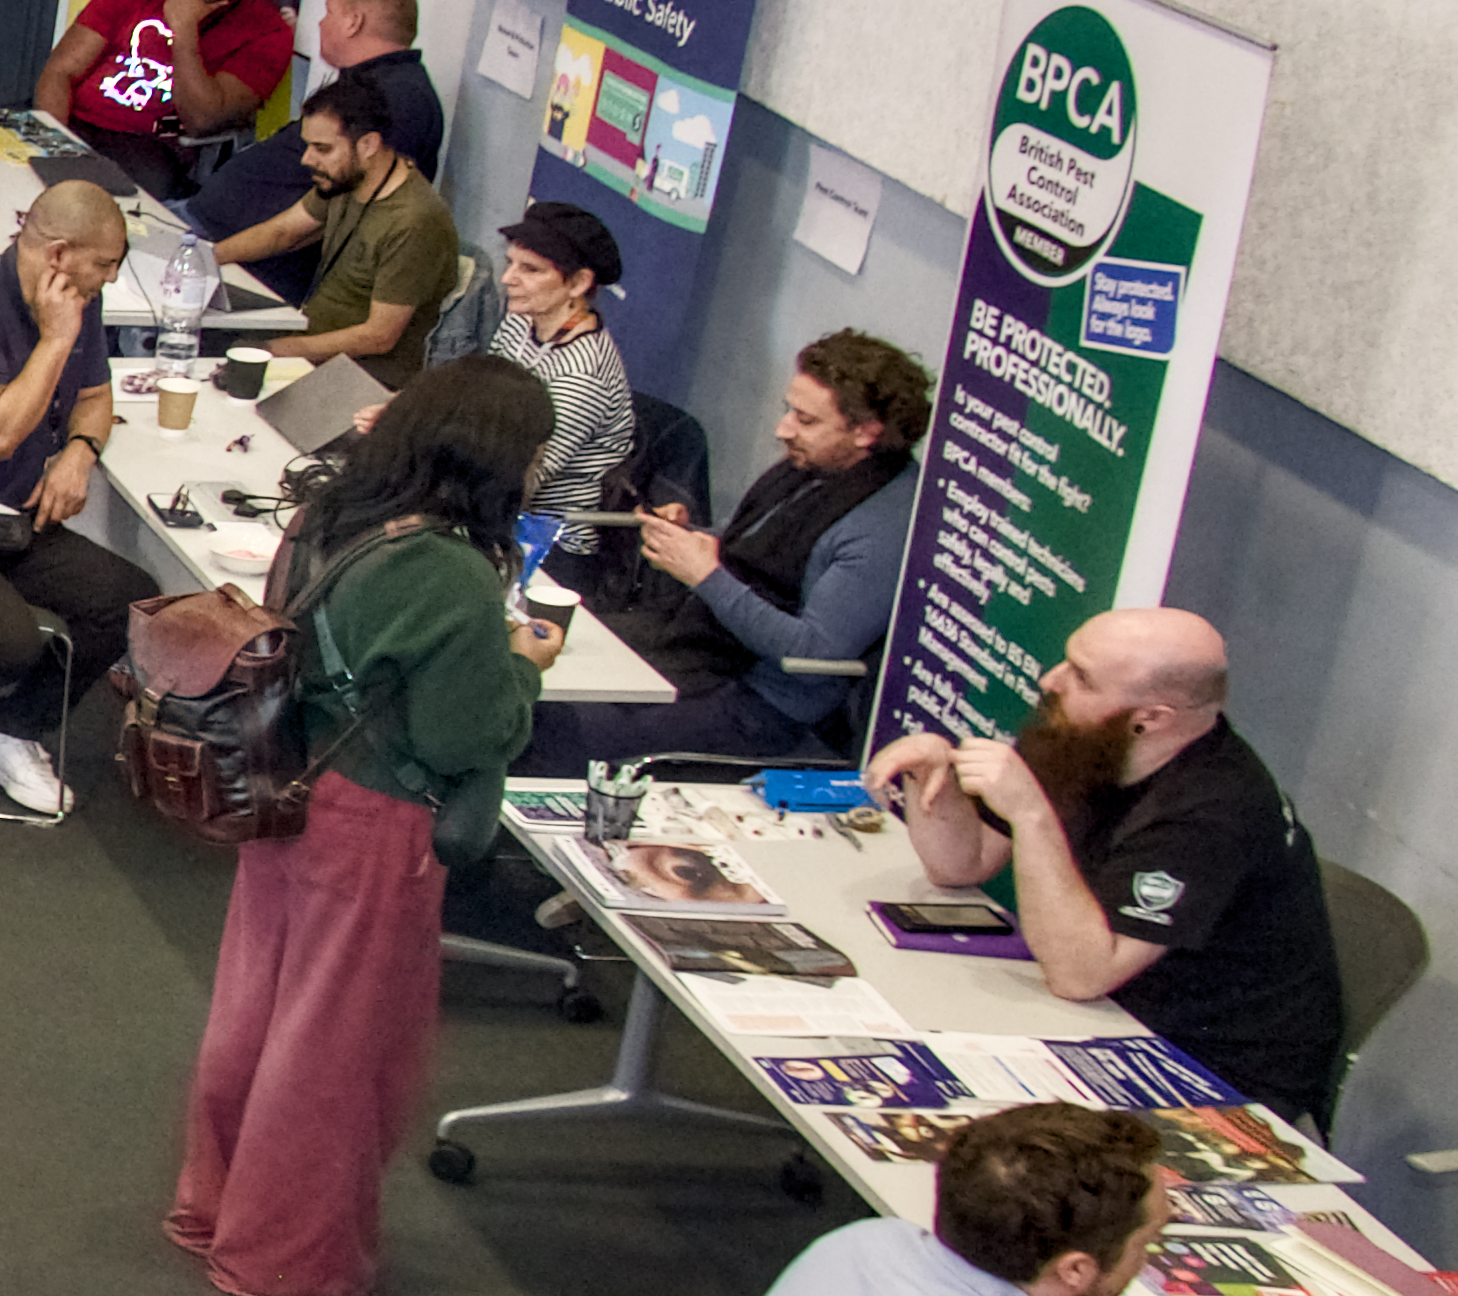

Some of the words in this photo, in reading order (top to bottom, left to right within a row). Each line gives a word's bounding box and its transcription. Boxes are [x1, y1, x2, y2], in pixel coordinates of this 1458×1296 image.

[1015, 42, 1123, 145] BPCA
[1019, 134, 1063, 172] British
[1066, 159, 1096, 189] Pest
[1027, 166, 1079, 206] Control
[1007, 184, 1085, 238] Association
[970, 298, 1001, 338] BE
[999, 314, 1112, 408] PROTECTED.
[963, 331, 1127, 456] PROFESSIONALLY.
